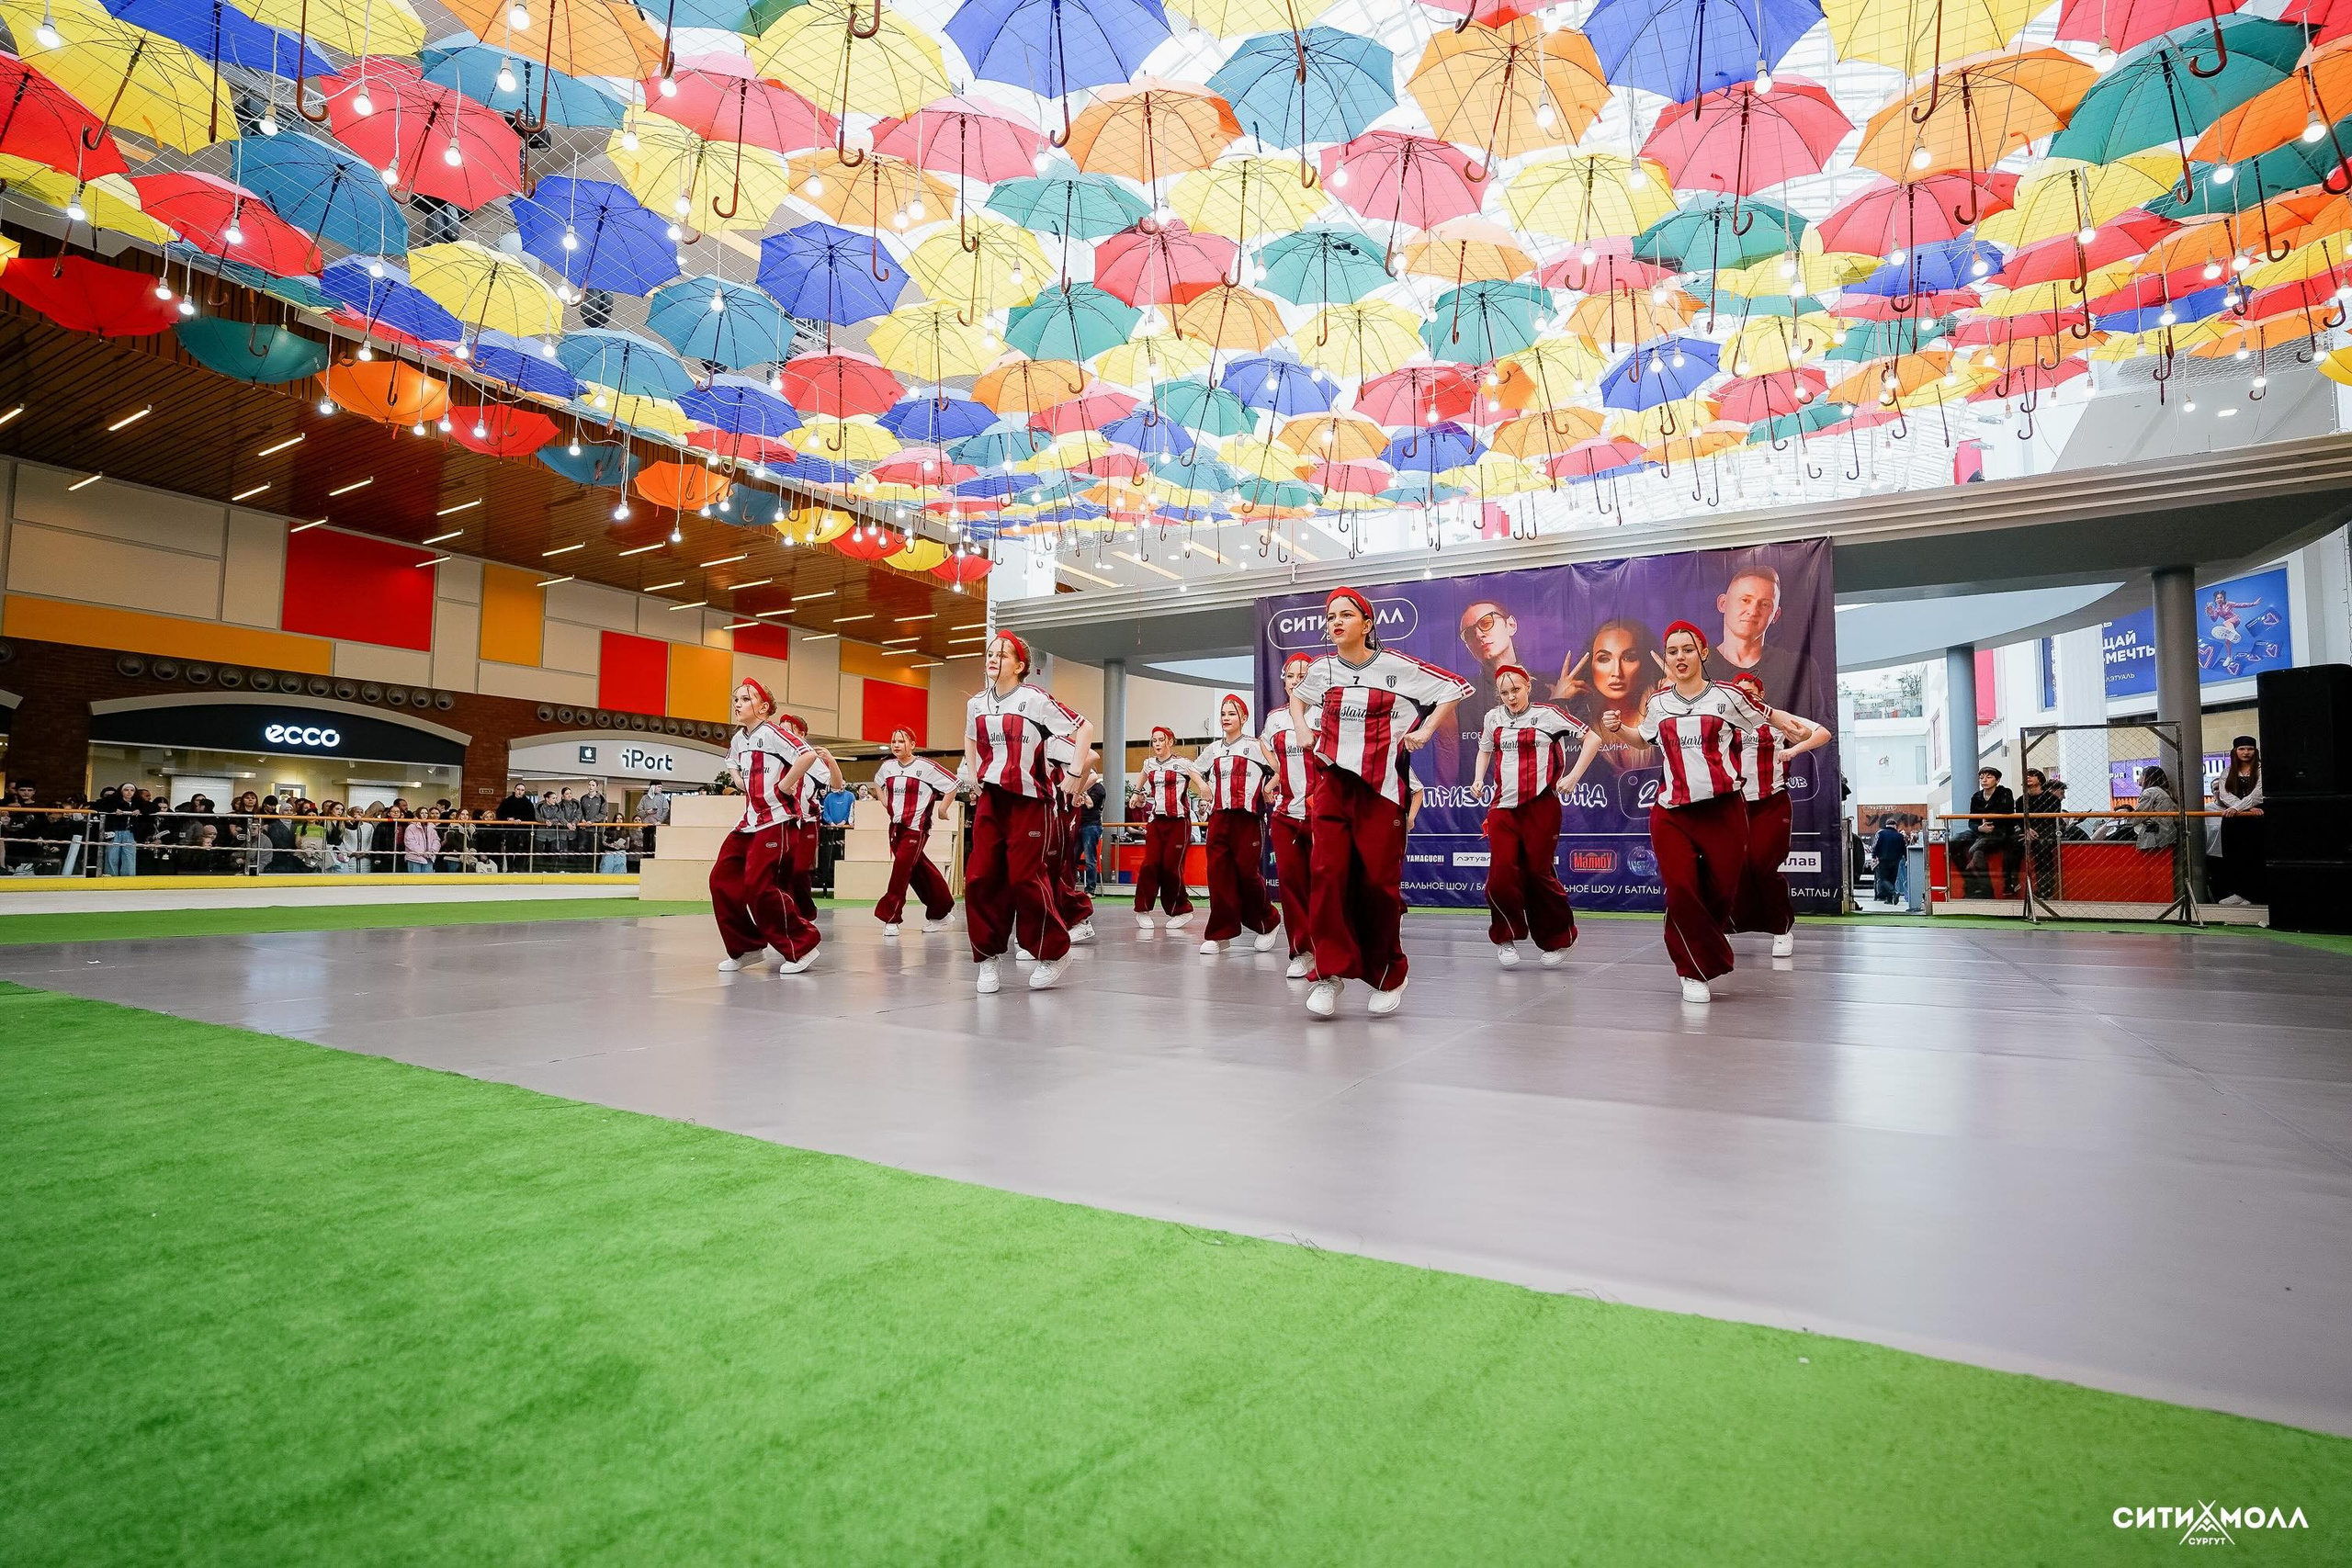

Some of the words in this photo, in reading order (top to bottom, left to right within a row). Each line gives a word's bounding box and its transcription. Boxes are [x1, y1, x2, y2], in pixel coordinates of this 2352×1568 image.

[265, 724, 341, 748] ecco
[1599, 742, 1630, 752] ЕДИНА
[622, 749, 673, 772] iPort
[1423, 785, 1495, 808] ПРИЗО
[1406, 854, 1444, 863] YAMAGUCHI
[1400, 881, 1444, 891] ЕВАЛЬНОЕ
[1446, 883, 1467, 891] ШОУ
[1591, 885, 1616, 894] ШОУ
[1624, 886, 1661, 895] БАТТЛЫ
[1791, 887, 1830, 897] БАТТЛЫ
